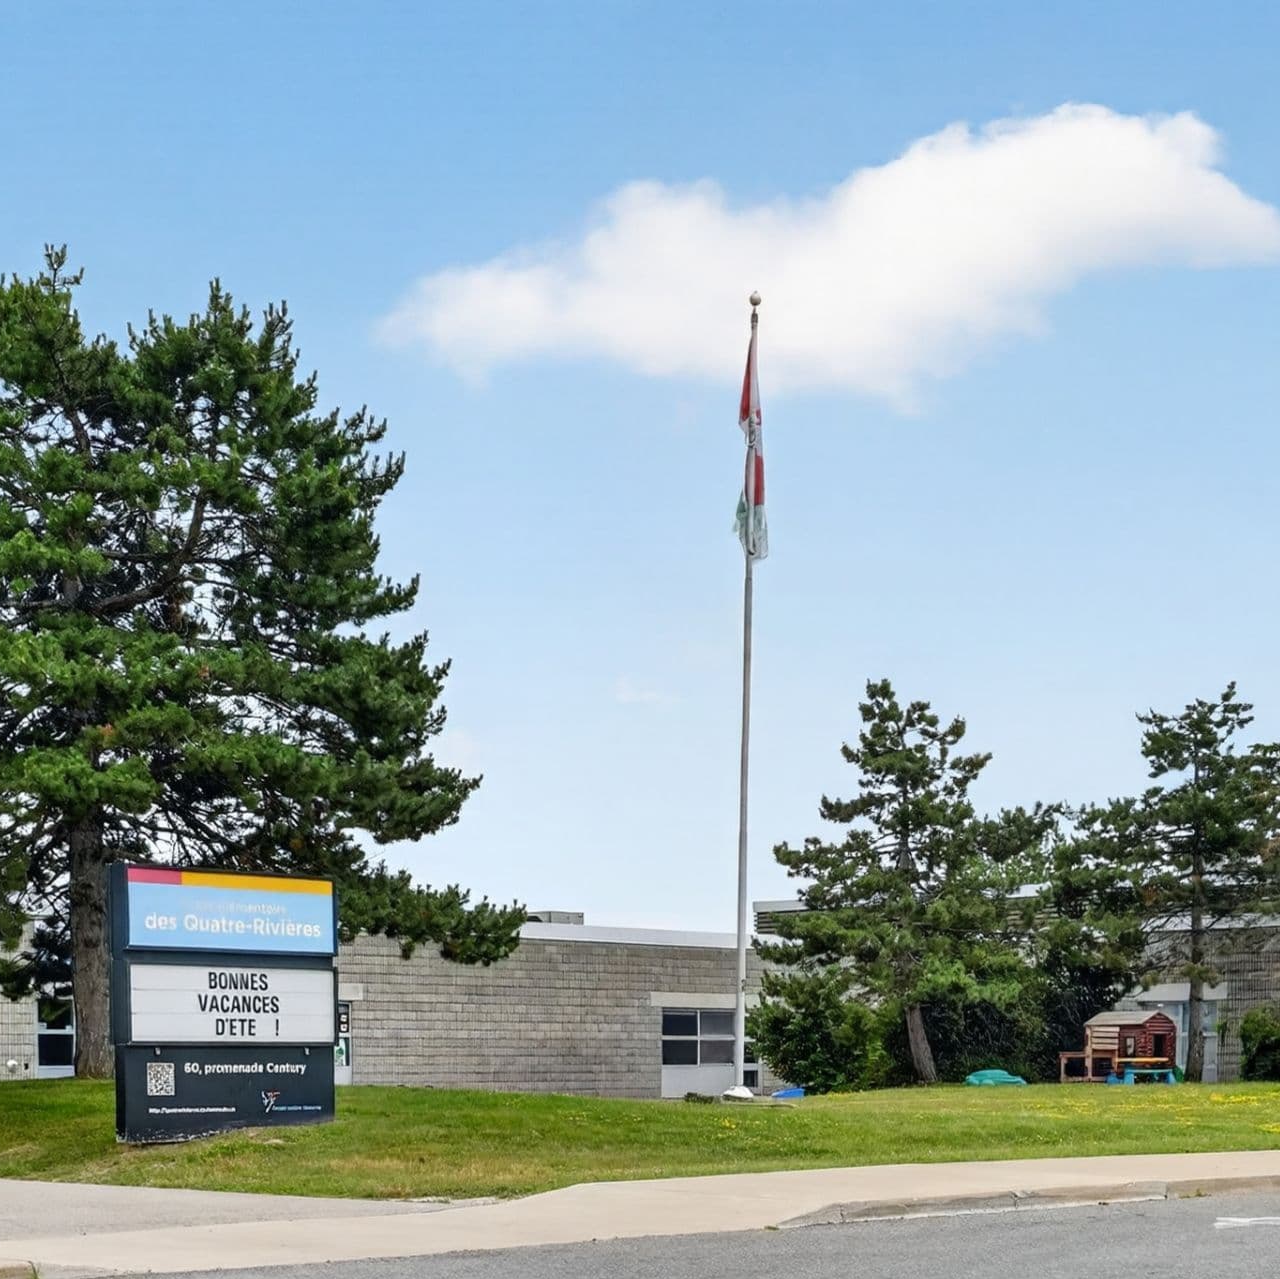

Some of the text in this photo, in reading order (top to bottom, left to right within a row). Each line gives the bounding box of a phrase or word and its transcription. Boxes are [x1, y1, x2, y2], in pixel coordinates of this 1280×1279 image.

[144, 912, 322, 938] des Quatre-Rivières
[208, 972, 268, 991] BONNES
[198, 993, 280, 1013] VACANCES
[215, 1018, 256, 1036] D'ETE
[184, 1062, 307, 1075] 60, promenade Century
